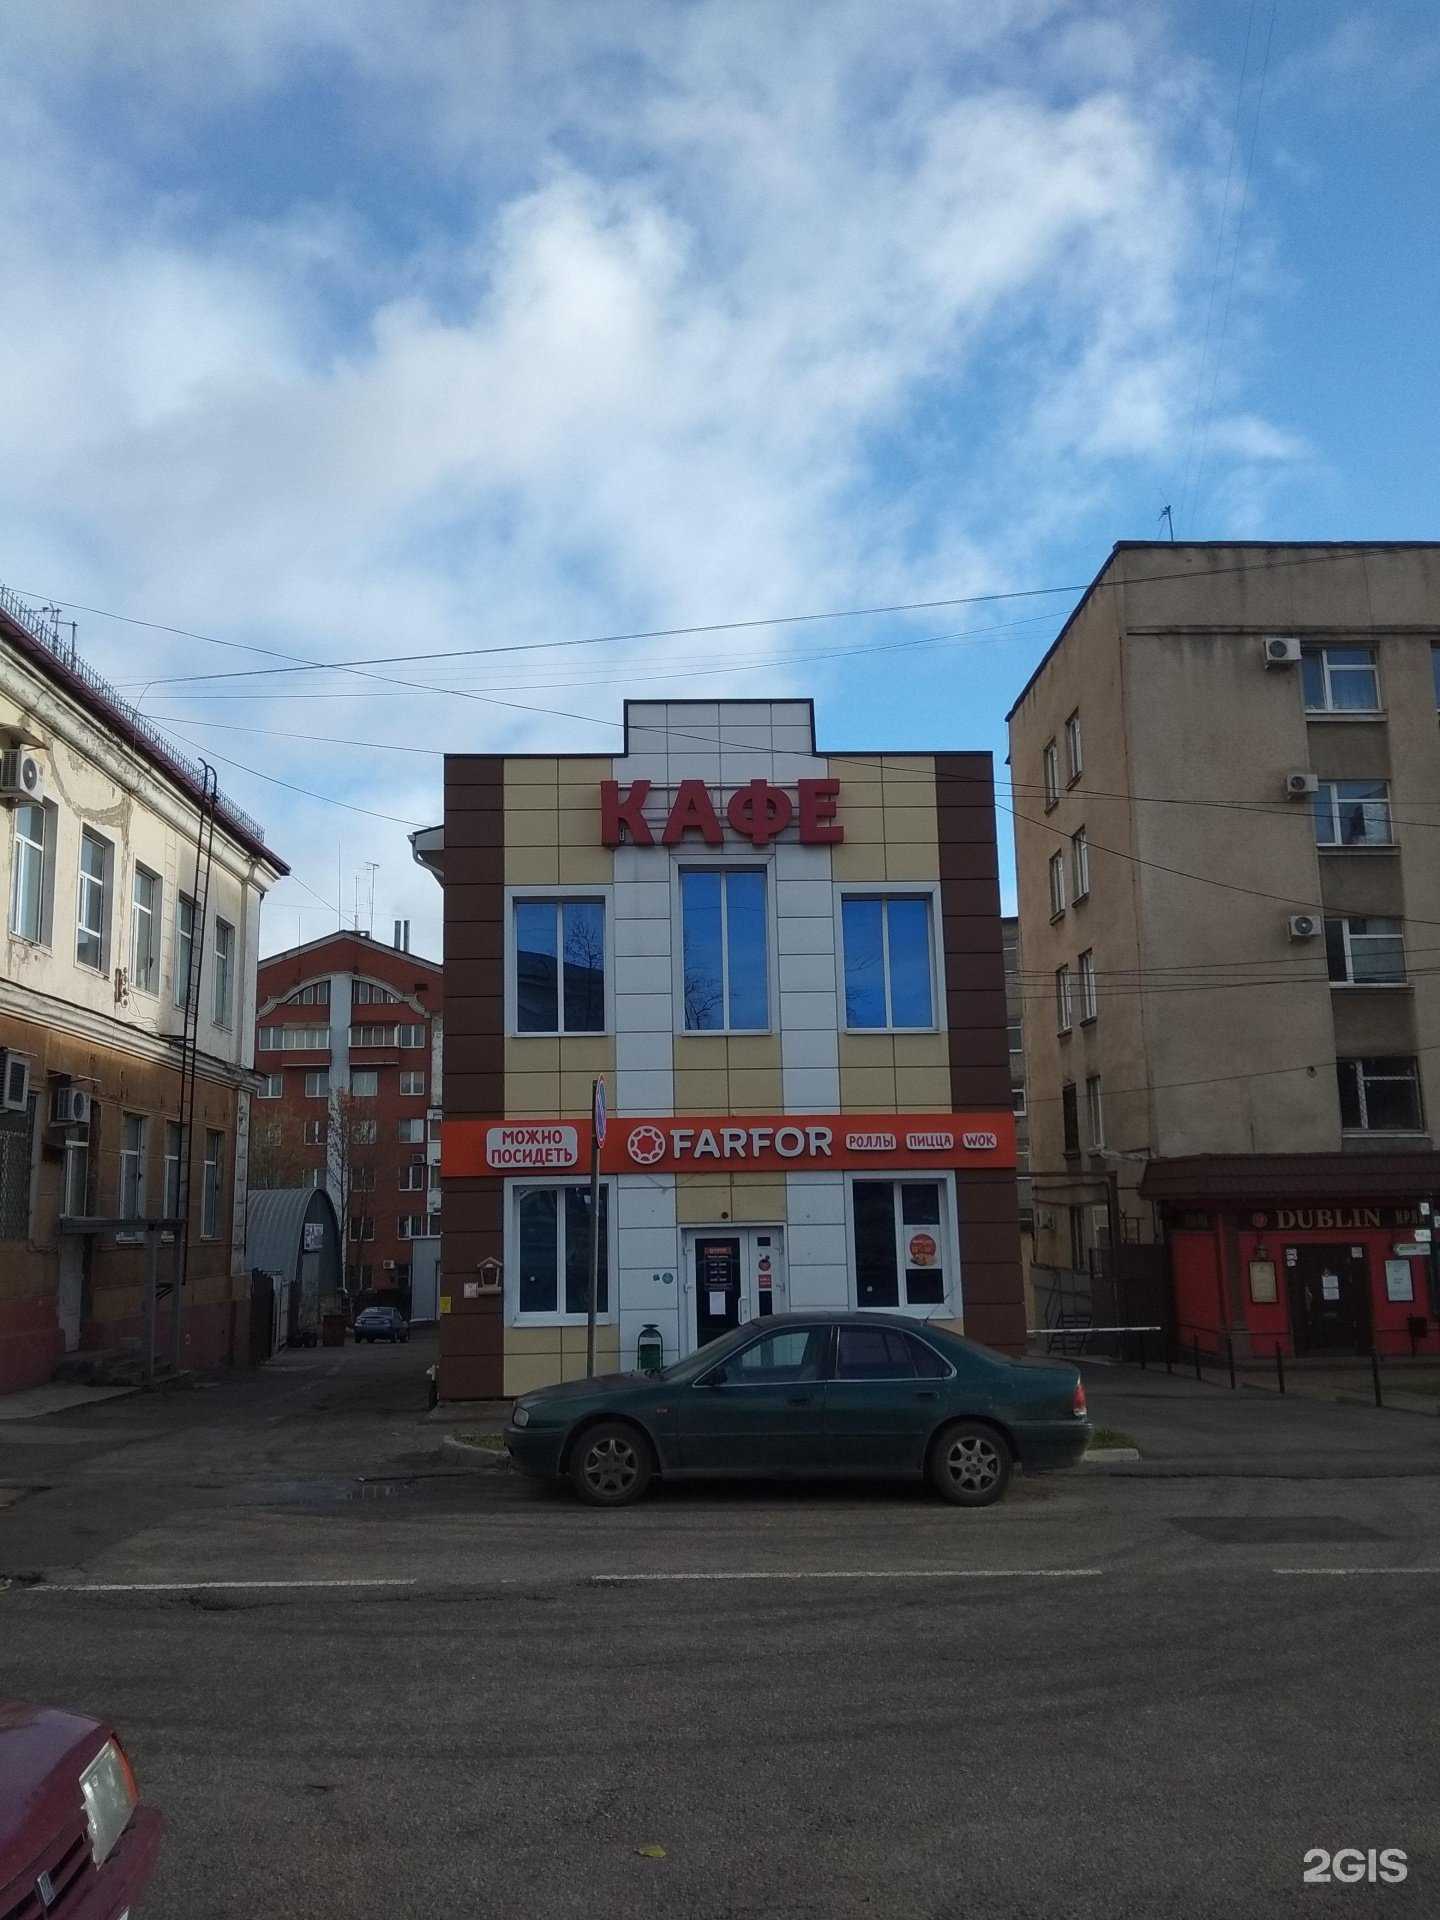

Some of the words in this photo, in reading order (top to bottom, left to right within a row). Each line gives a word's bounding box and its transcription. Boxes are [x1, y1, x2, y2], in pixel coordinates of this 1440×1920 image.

[600, 778, 845, 847] КАФЕ
[502, 1129, 563, 1145] МОЖНО
[670, 1127, 832, 1158] FARFOR
[849, 1135, 894, 1148] РОЛЛЫ
[909, 1134, 951, 1149] ПИЦЦА
[965, 1134, 995, 1146] WOK
[491, 1147, 573, 1166] ПОСИДЕТЬ
[1275, 1208, 1382, 1229] DUBLIN
